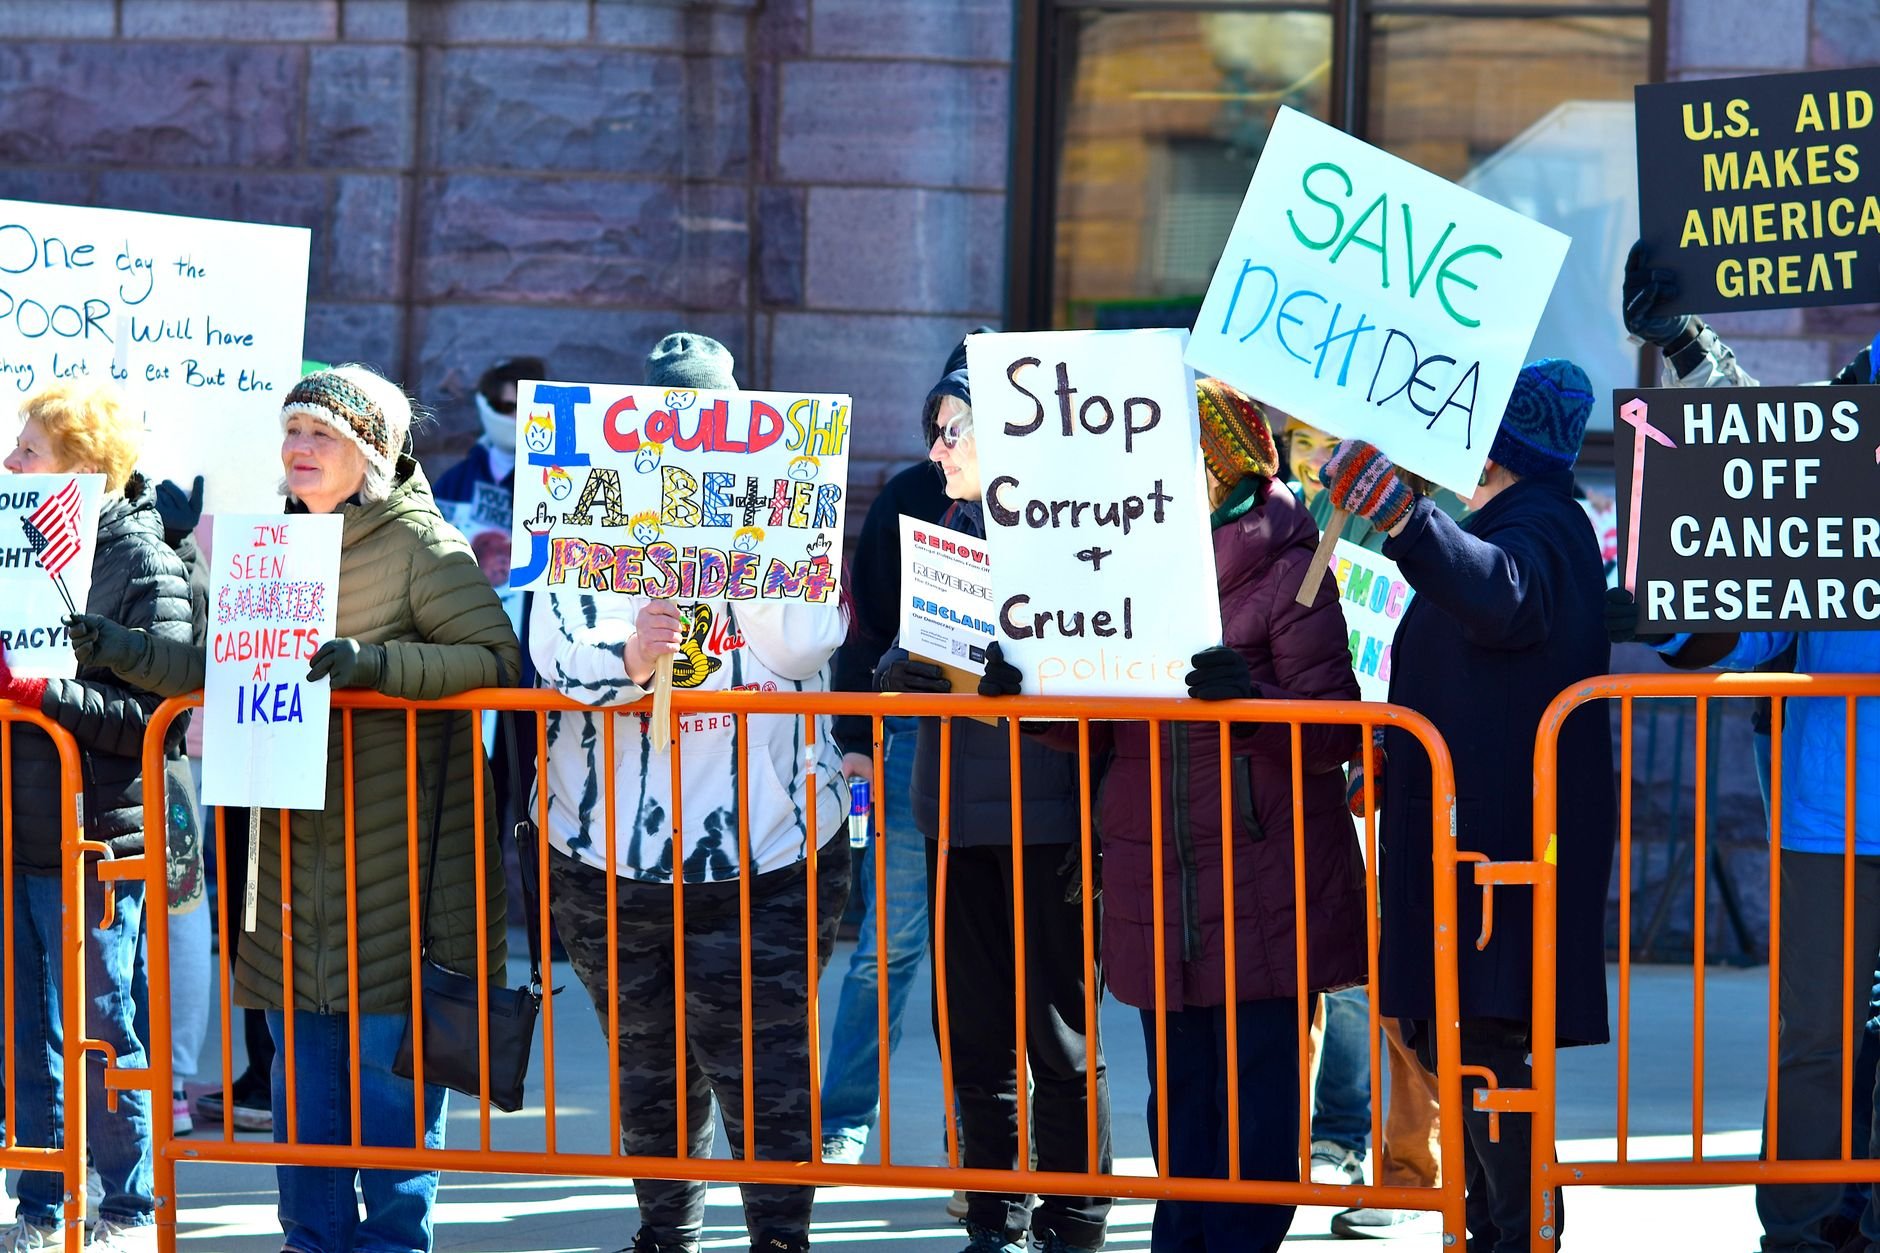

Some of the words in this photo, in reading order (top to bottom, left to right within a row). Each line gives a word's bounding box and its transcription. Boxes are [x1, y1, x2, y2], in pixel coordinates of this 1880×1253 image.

[1682, 99, 1759, 141] U.S.
[1795, 90, 1874, 133] AID
[1703, 144, 1860, 192] MAKES
[1679, 195, 1880, 248] AMERICA
[0, 224, 95, 273] One
[116, 239, 153, 305] day
[172, 254, 206, 278] the
[1286, 162, 1503, 327] SAVE
[1715, 250, 1858, 298] GREAT
[206, 315, 254, 346] have
[0, 357, 34, 392] hing
[111, 357, 128, 380] to
[180, 359, 225, 387] But
[238, 369, 273, 392] the
[528, 384, 592, 467] I
[1003, 356, 1161, 453] Stop
[1683, 400, 1860, 445] HANDS
[562, 468, 628, 528] A
[1723, 458, 1821, 499] OFF
[986, 475, 1174, 535] Corrupt
[254, 525, 289, 547] I'VE
[1670, 515, 1880, 558] CANCER
[229, 554, 286, 580] SEEN
[913, 562, 993, 602] REVERSE
[1328, 553, 1416, 620] EMOC
[218, 581, 325, 624] SMARTER
[912, 595, 996, 636] RECLAIM
[1000, 593, 1133, 640] Cruel
[1647, 578, 1880, 621] RESEARC
[214, 627, 320, 663] CABINETS
[707, 612, 746, 656] Kai
[252, 662, 271, 682] AT
[1038, 647, 1185, 696] policie
[237, 682, 303, 724] IKEA
[679, 715, 732, 733] MERC
